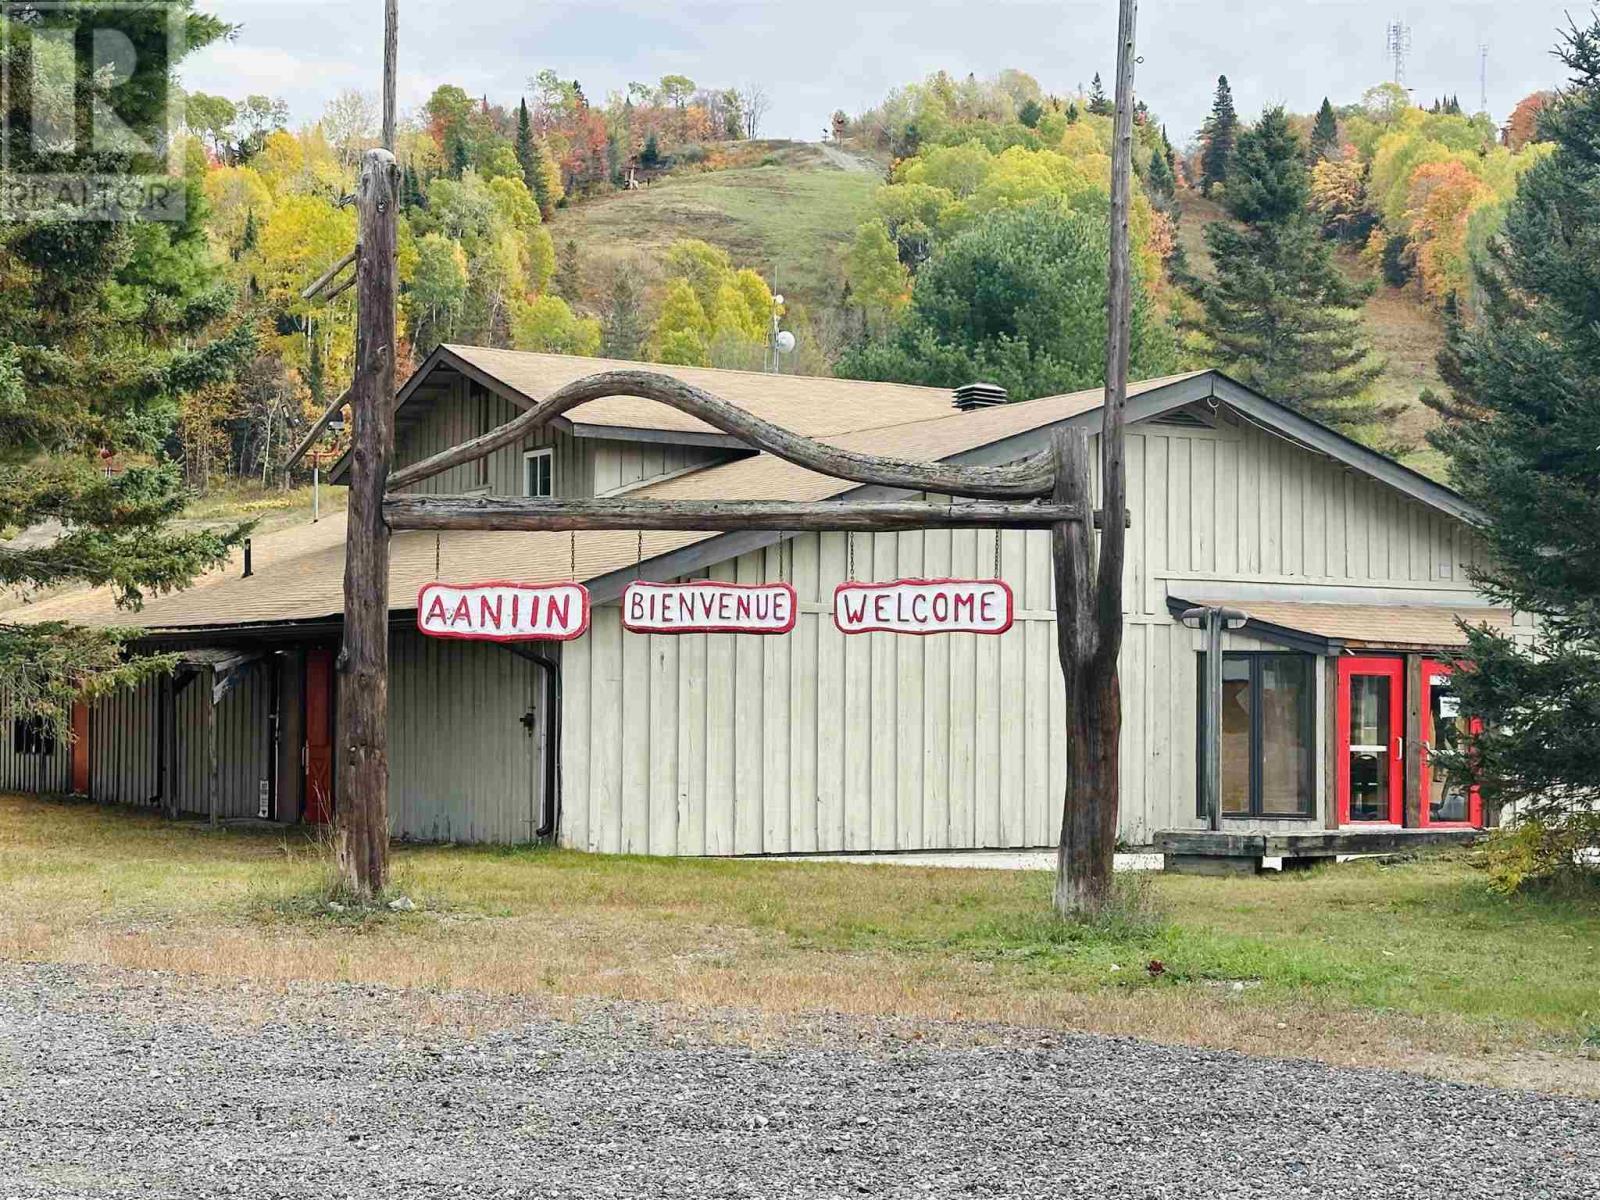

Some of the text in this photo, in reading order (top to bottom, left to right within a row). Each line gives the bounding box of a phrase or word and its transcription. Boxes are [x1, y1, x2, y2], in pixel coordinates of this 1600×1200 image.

[425, 594, 571, 629] AANIIN
[630, 592, 786, 623] BIENVENUE
[844, 591, 996, 624] WELCOME
